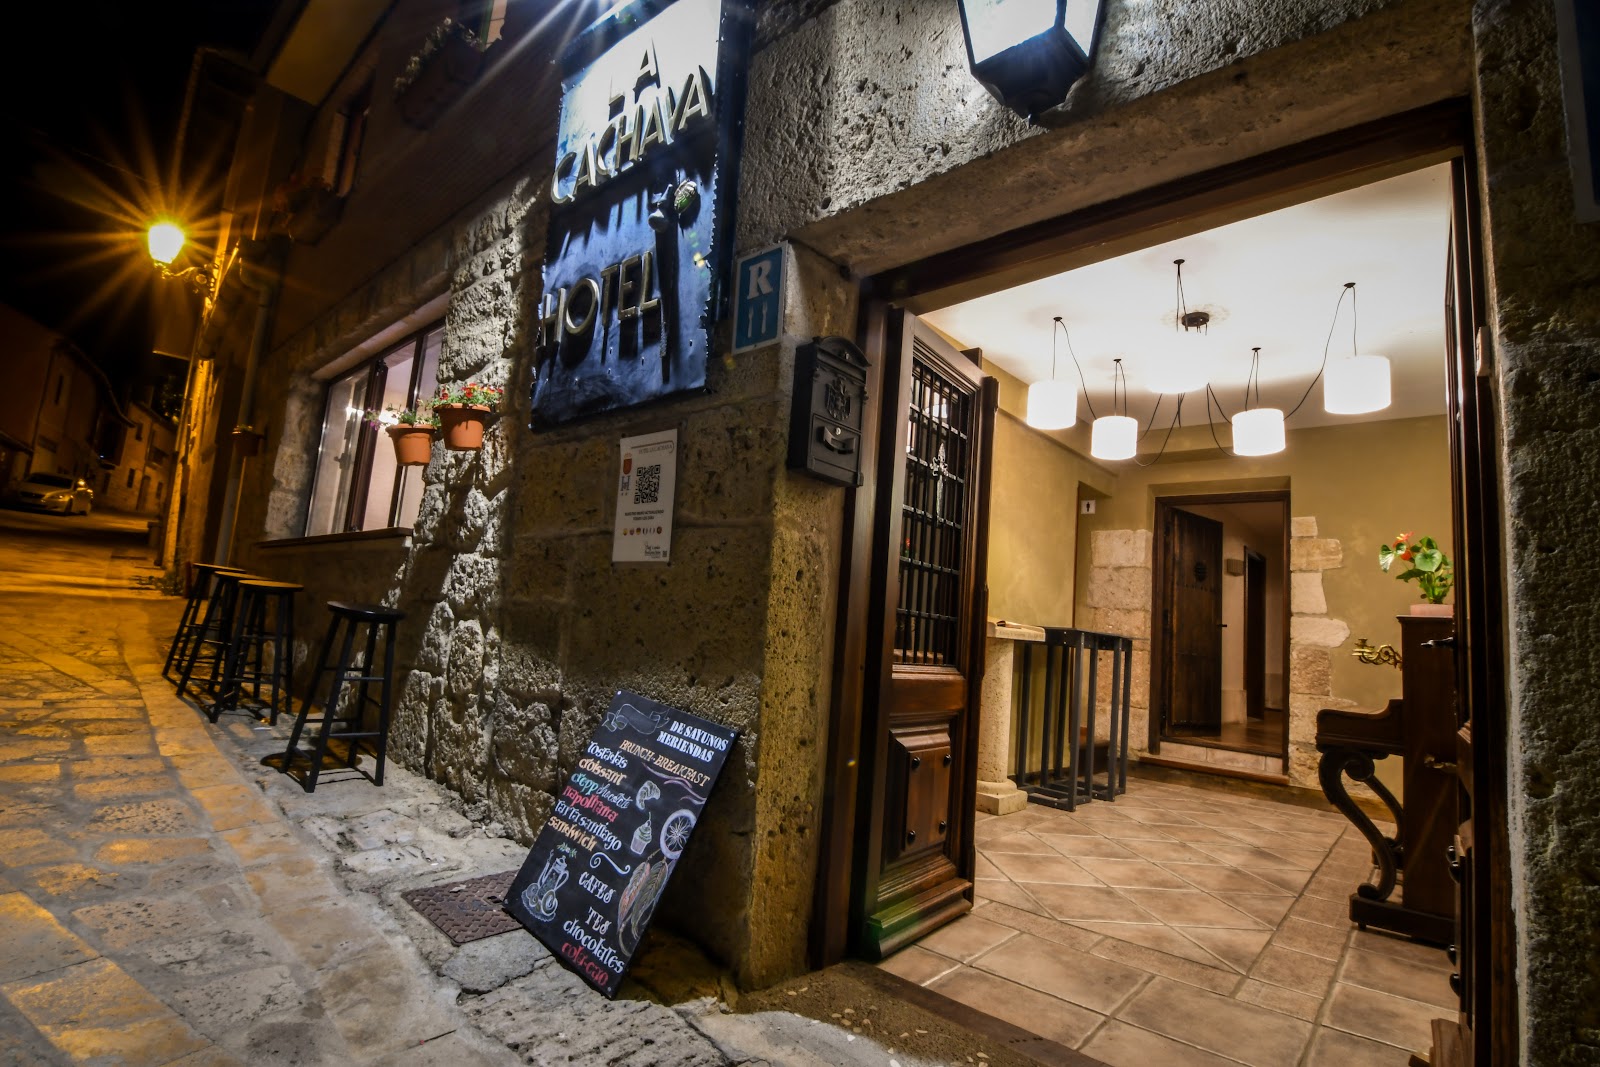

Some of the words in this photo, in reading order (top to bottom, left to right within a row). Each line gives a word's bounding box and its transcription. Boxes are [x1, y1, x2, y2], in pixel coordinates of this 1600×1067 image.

[551, 65, 712, 204] CACHAVA
[747, 261, 774, 299] R
[541, 250, 662, 349] HOTEL
[656, 731, 714, 763] MERIENDAS
[571, 772, 598, 796] crepp
[547, 815, 598, 852] sandwich
[578, 871, 616, 904] CAFES
[584, 906, 612, 935] TES
[561, 942, 609, 986] cola-cao
[563, 918, 625, 974] chocolates
